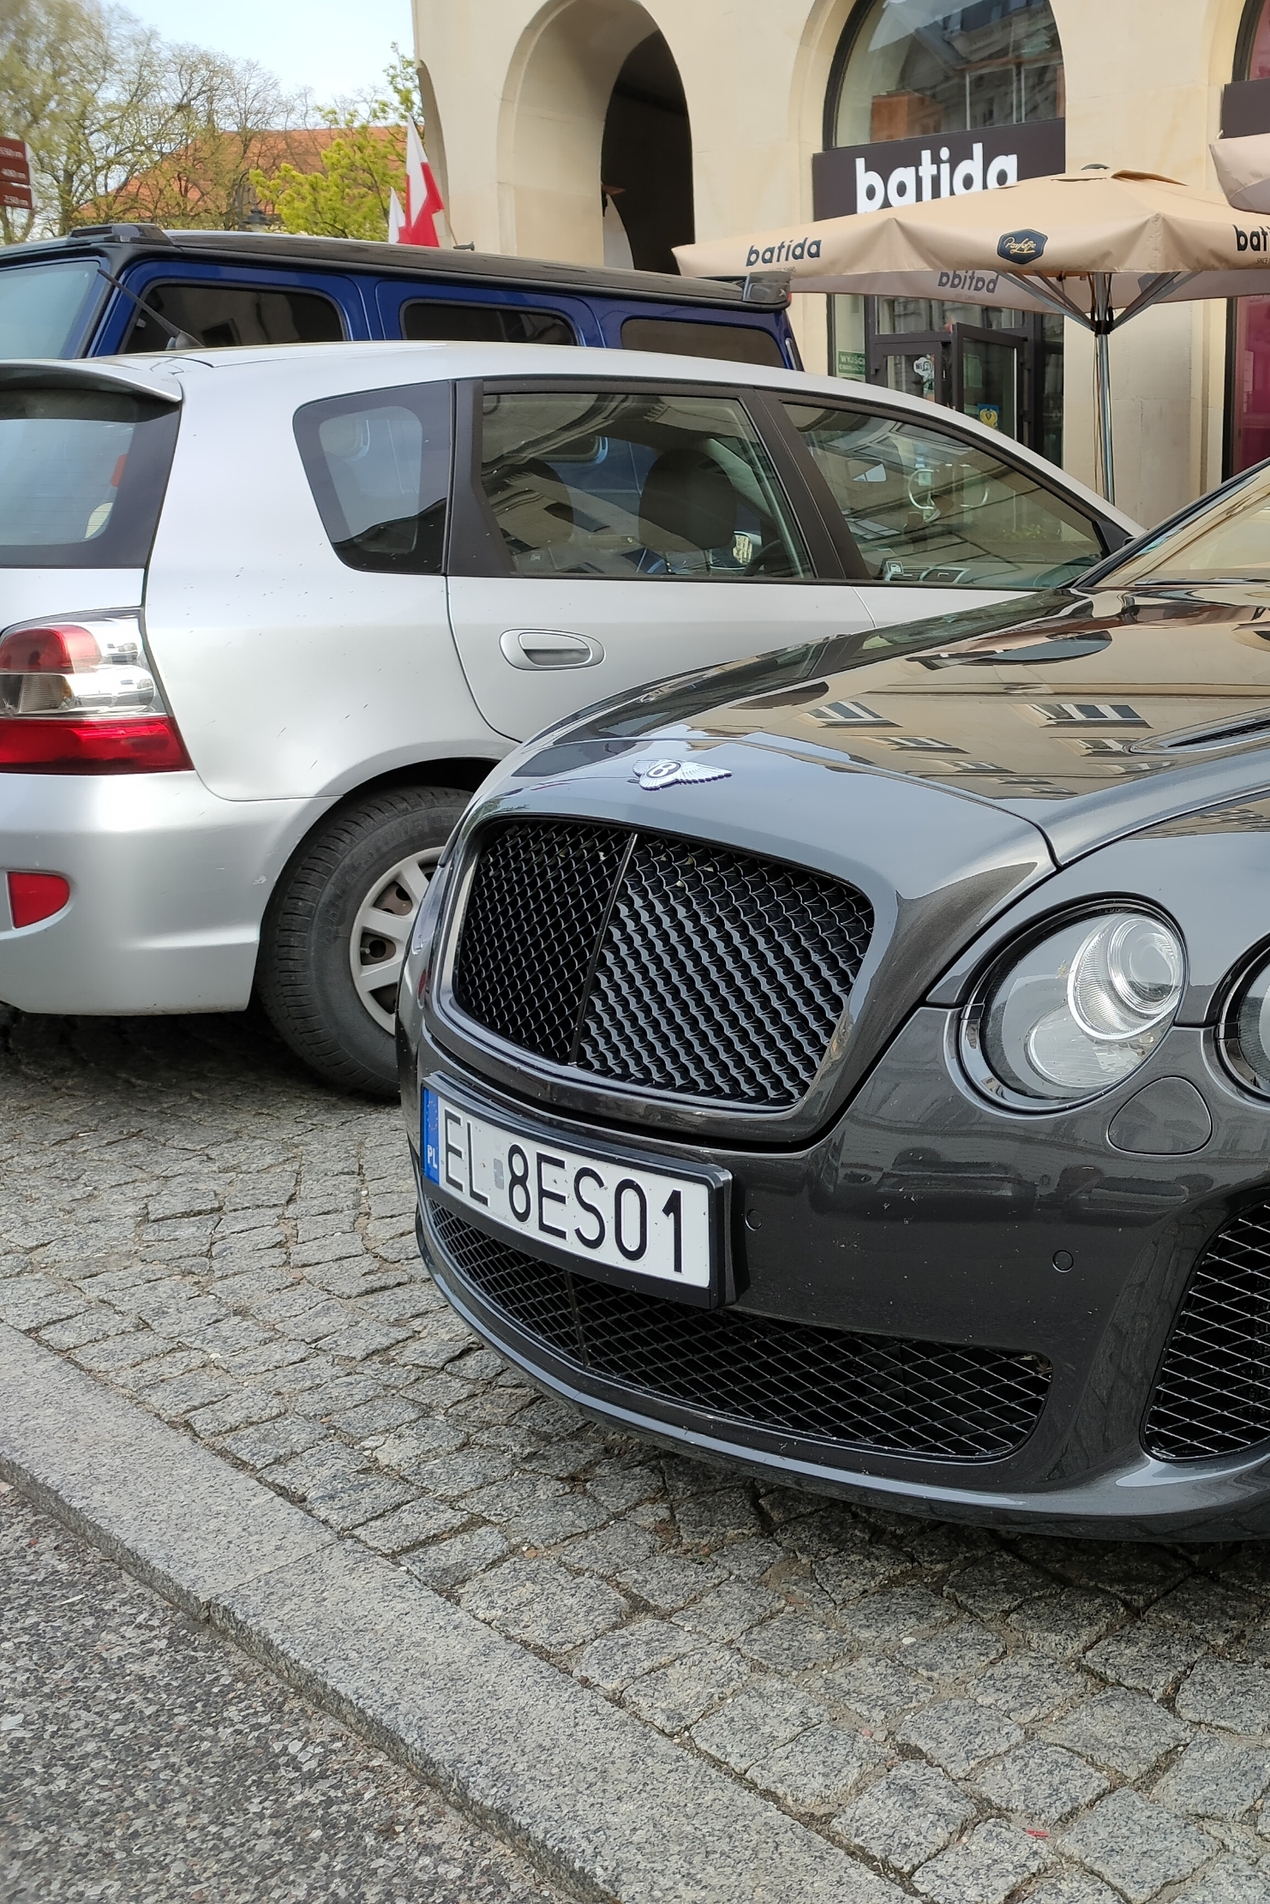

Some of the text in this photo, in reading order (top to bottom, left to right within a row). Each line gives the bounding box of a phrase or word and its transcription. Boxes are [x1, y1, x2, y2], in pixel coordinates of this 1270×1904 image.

[855, 142, 1018, 214] batida
[745, 237, 822, 267] batida
[427, 1144, 438, 1169] PL
[445, 1108, 683, 1274] EL 8ES01
